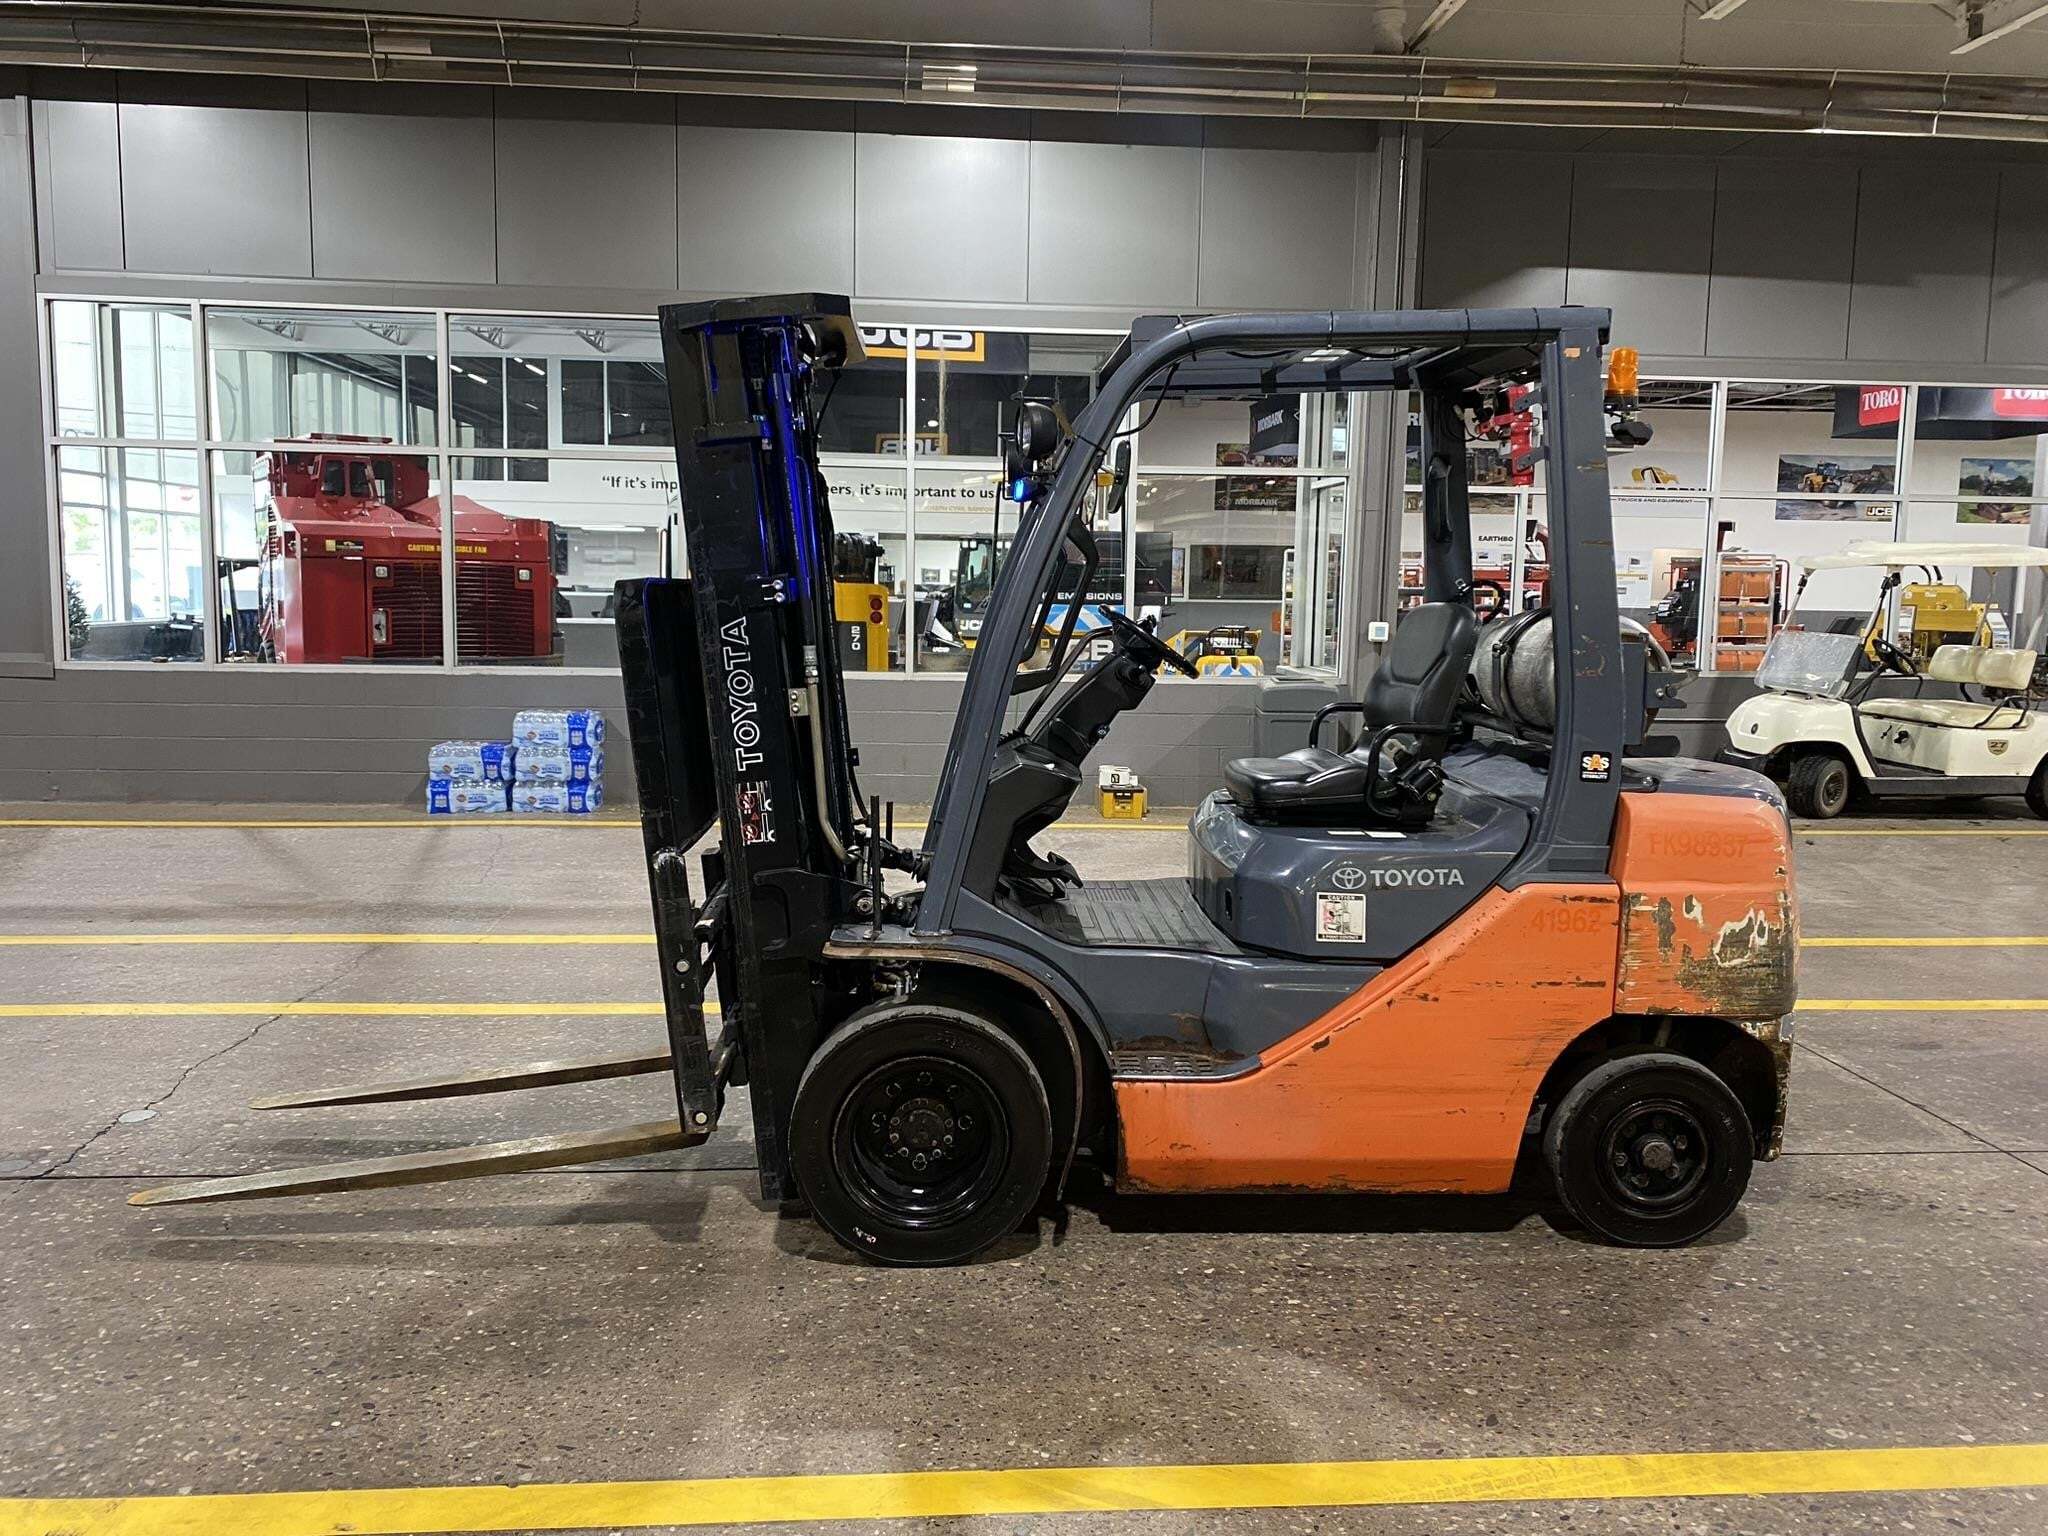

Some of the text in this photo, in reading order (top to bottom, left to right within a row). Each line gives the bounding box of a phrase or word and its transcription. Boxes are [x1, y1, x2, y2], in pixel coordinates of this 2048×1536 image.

[961, 486, 975, 498] to
[720, 615, 764, 772] TOYOTA
[1582, 754, 1610, 771] SAS
[1369, 868, 1465, 887] TOYOTA
